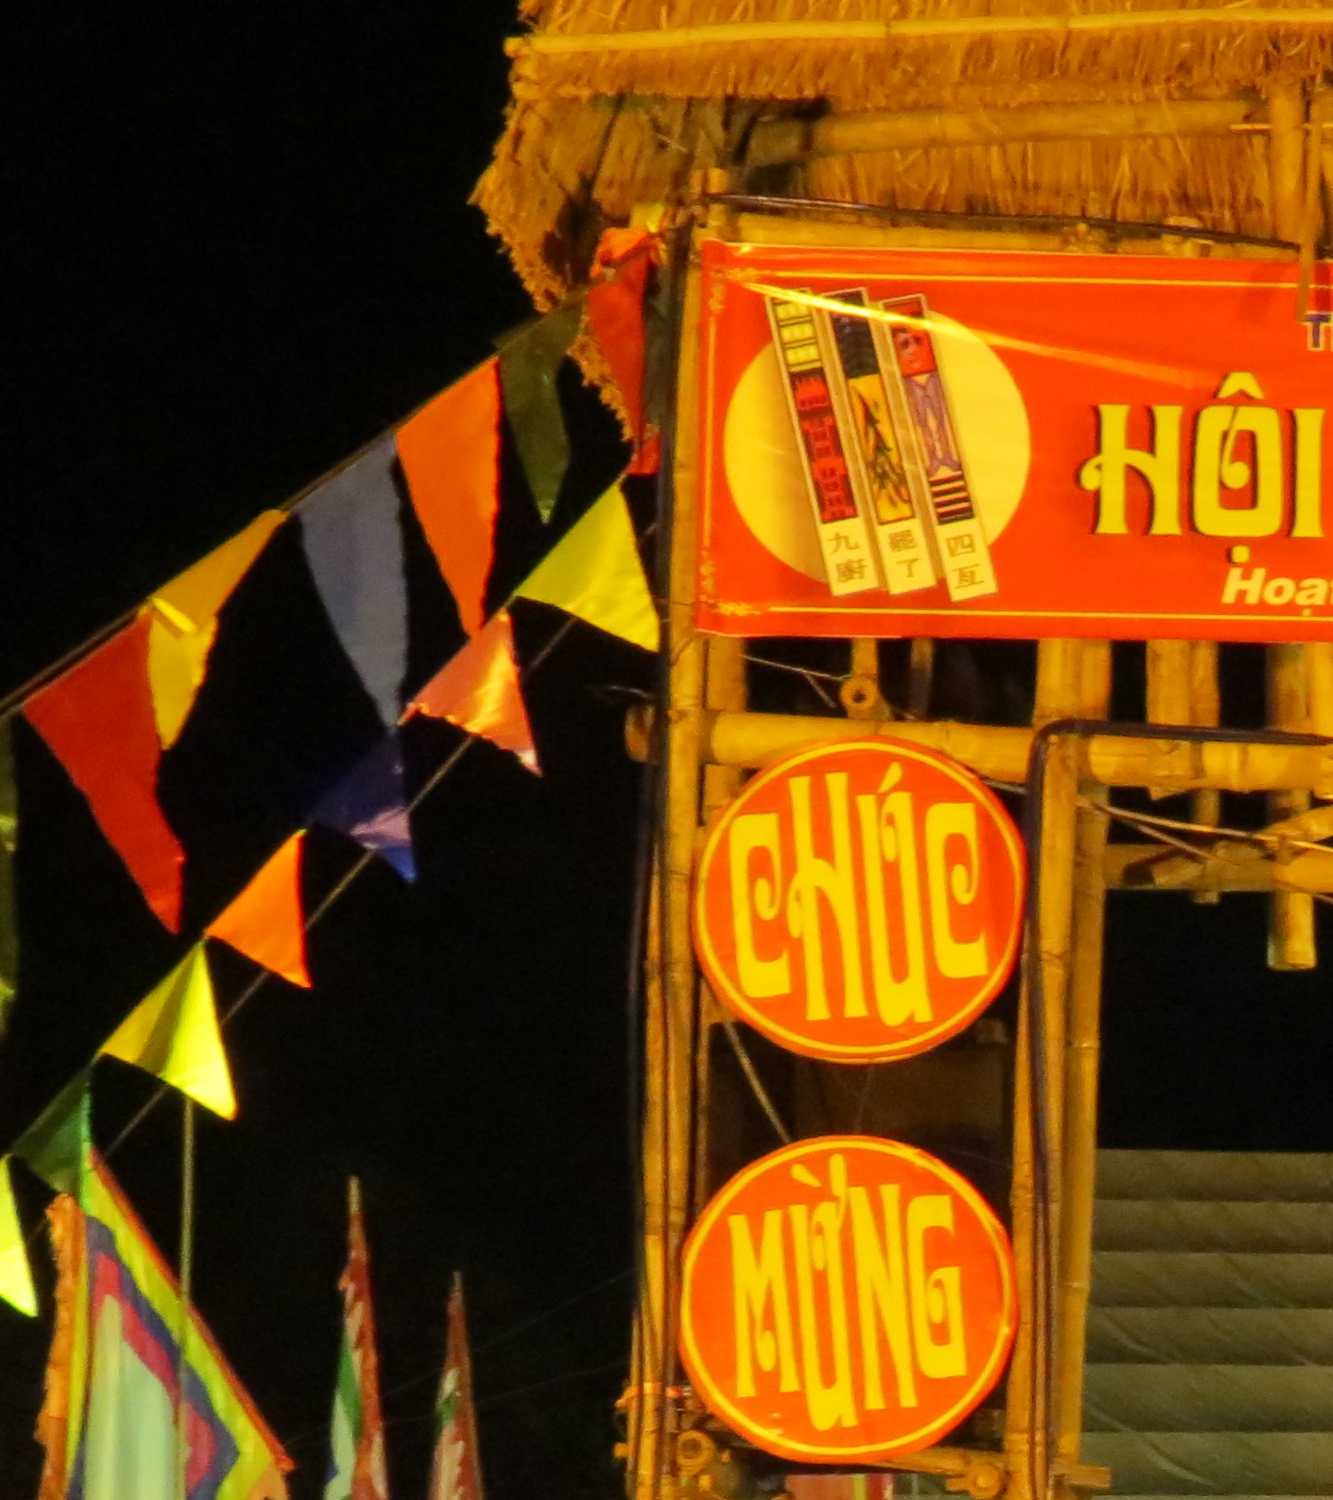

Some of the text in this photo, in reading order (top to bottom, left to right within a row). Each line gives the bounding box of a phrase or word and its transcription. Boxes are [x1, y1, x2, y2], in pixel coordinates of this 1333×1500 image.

[1081, 372, 1325, 563] HỘI
[729, 762, 988, 1026] CHÚC
[729, 1154, 967, 1430] MỪNG
